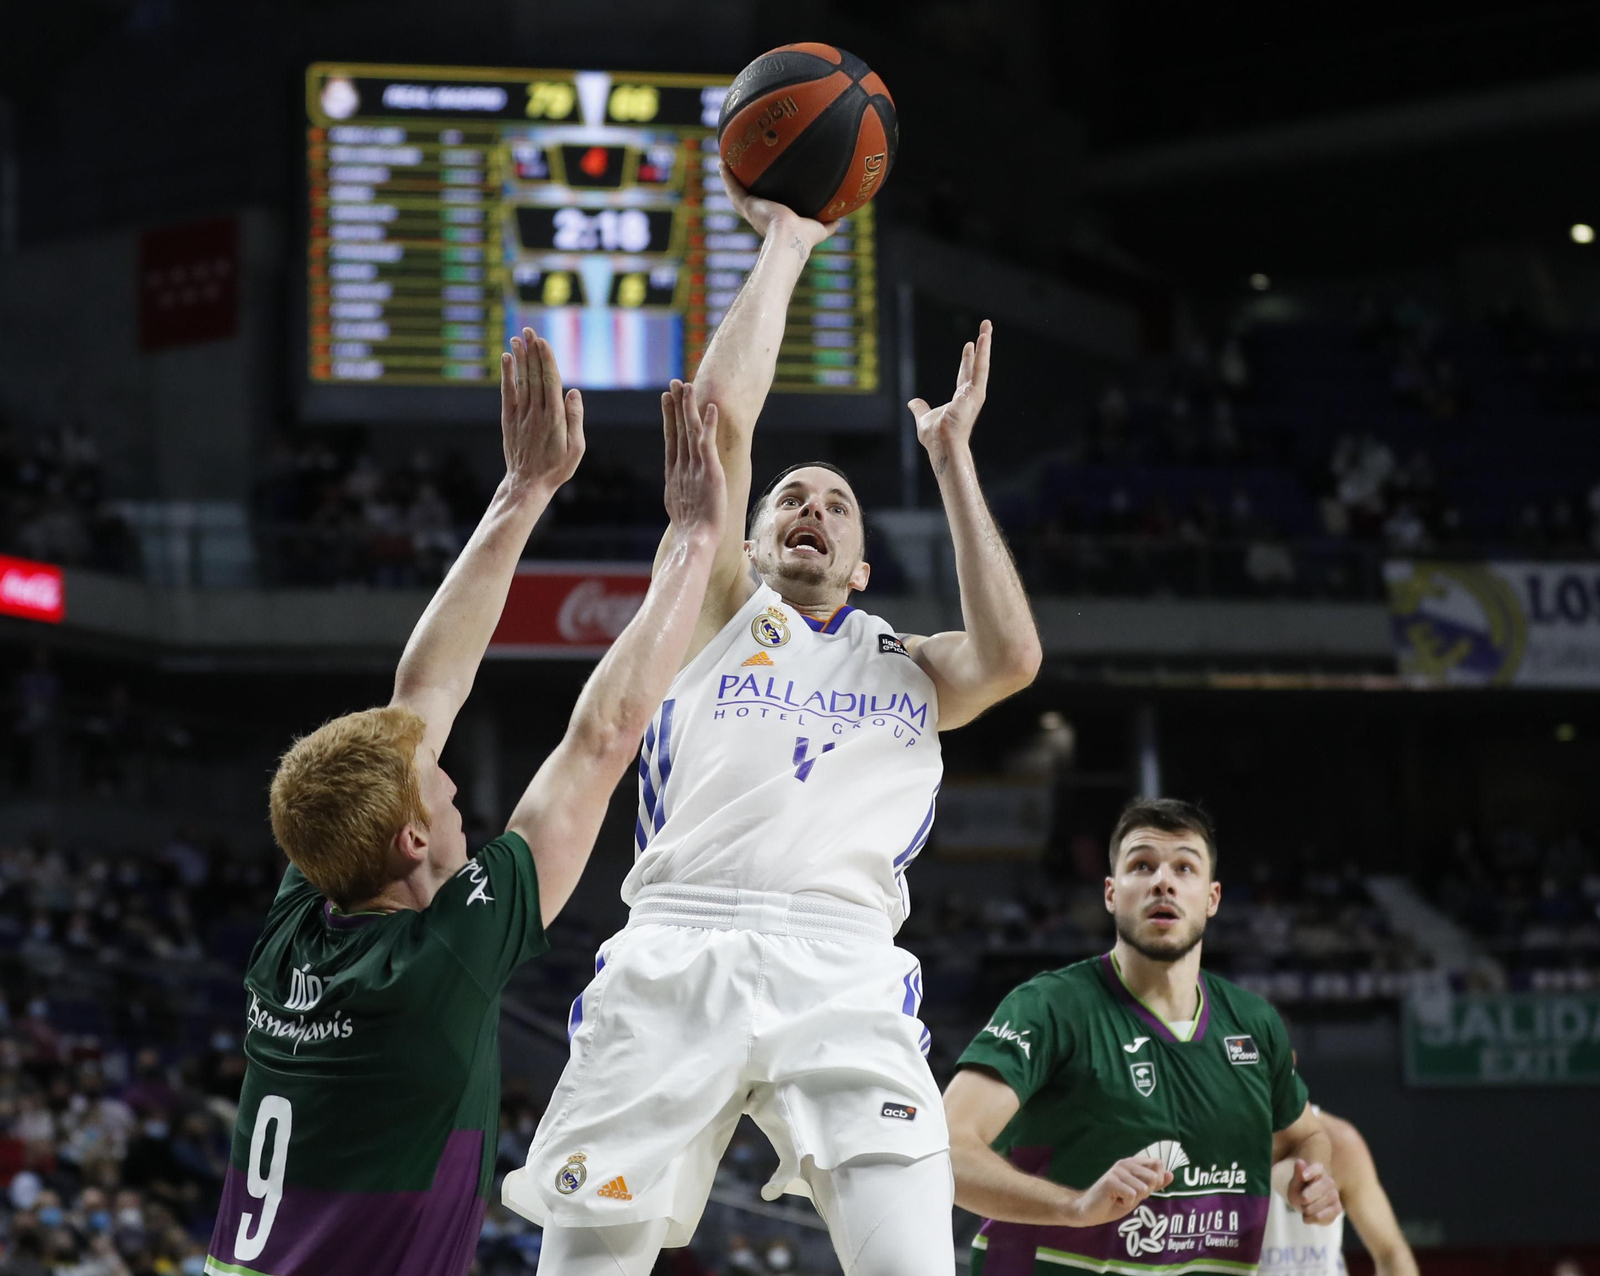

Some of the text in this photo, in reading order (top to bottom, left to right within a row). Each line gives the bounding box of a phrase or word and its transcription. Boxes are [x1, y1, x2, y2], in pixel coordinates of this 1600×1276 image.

[526, 81, 574, 119] 79
[1528, 574, 1600, 626] LO
[717, 673, 928, 728] PALLADIUM
[714, 707, 806, 726] HOTEL
[883, 1108, 908, 1118] acb
[234, 1094, 293, 1262] 9
[1184, 1161, 1247, 1189] Unicaja
[597, 1189, 632, 1200] adidas
[1167, 1238, 1195, 1253] Deporte
[1205, 1234, 1239, 1248] Eventos
